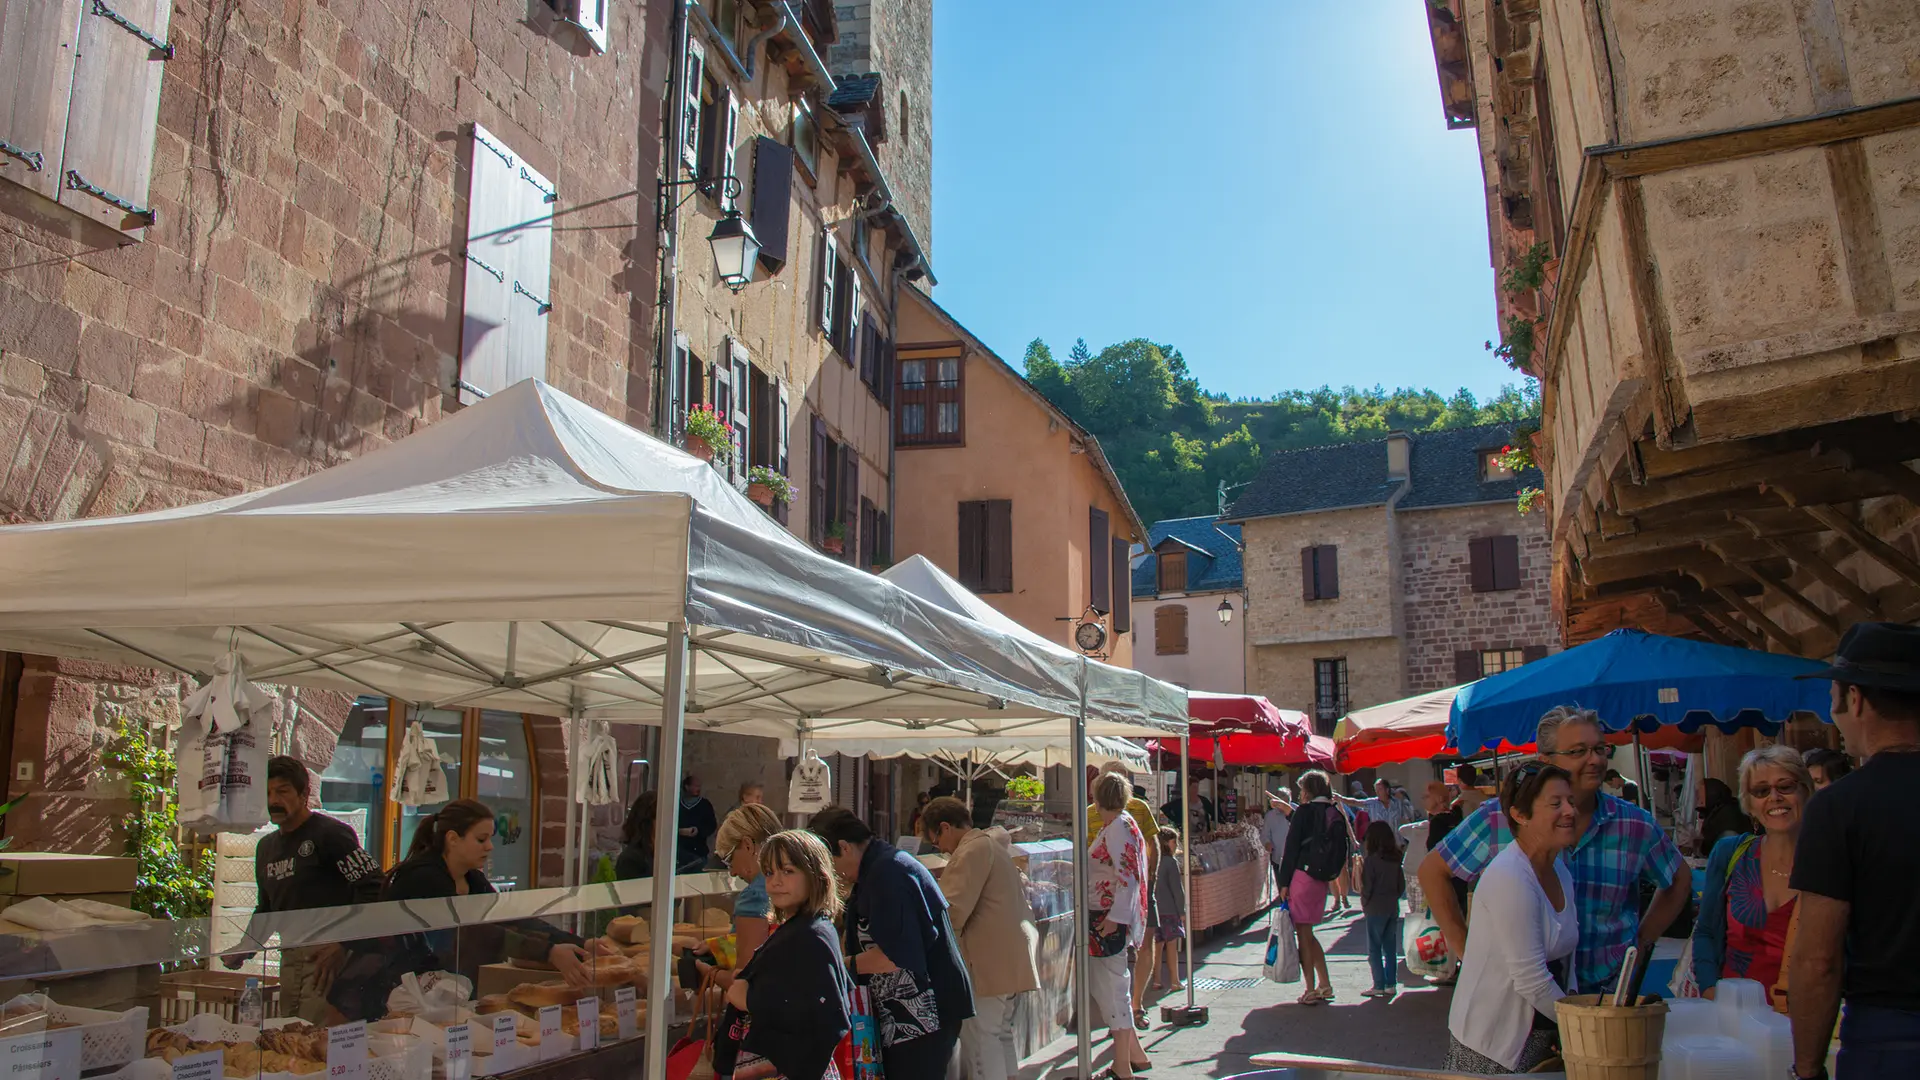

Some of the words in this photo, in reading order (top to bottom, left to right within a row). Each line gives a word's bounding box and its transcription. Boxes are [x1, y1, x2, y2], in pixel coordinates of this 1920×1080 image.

[10, 1040, 53, 1054] Croissants
[173, 1061, 202, 1072] Croissants
[331, 1064, 346, 1077] 5,20
